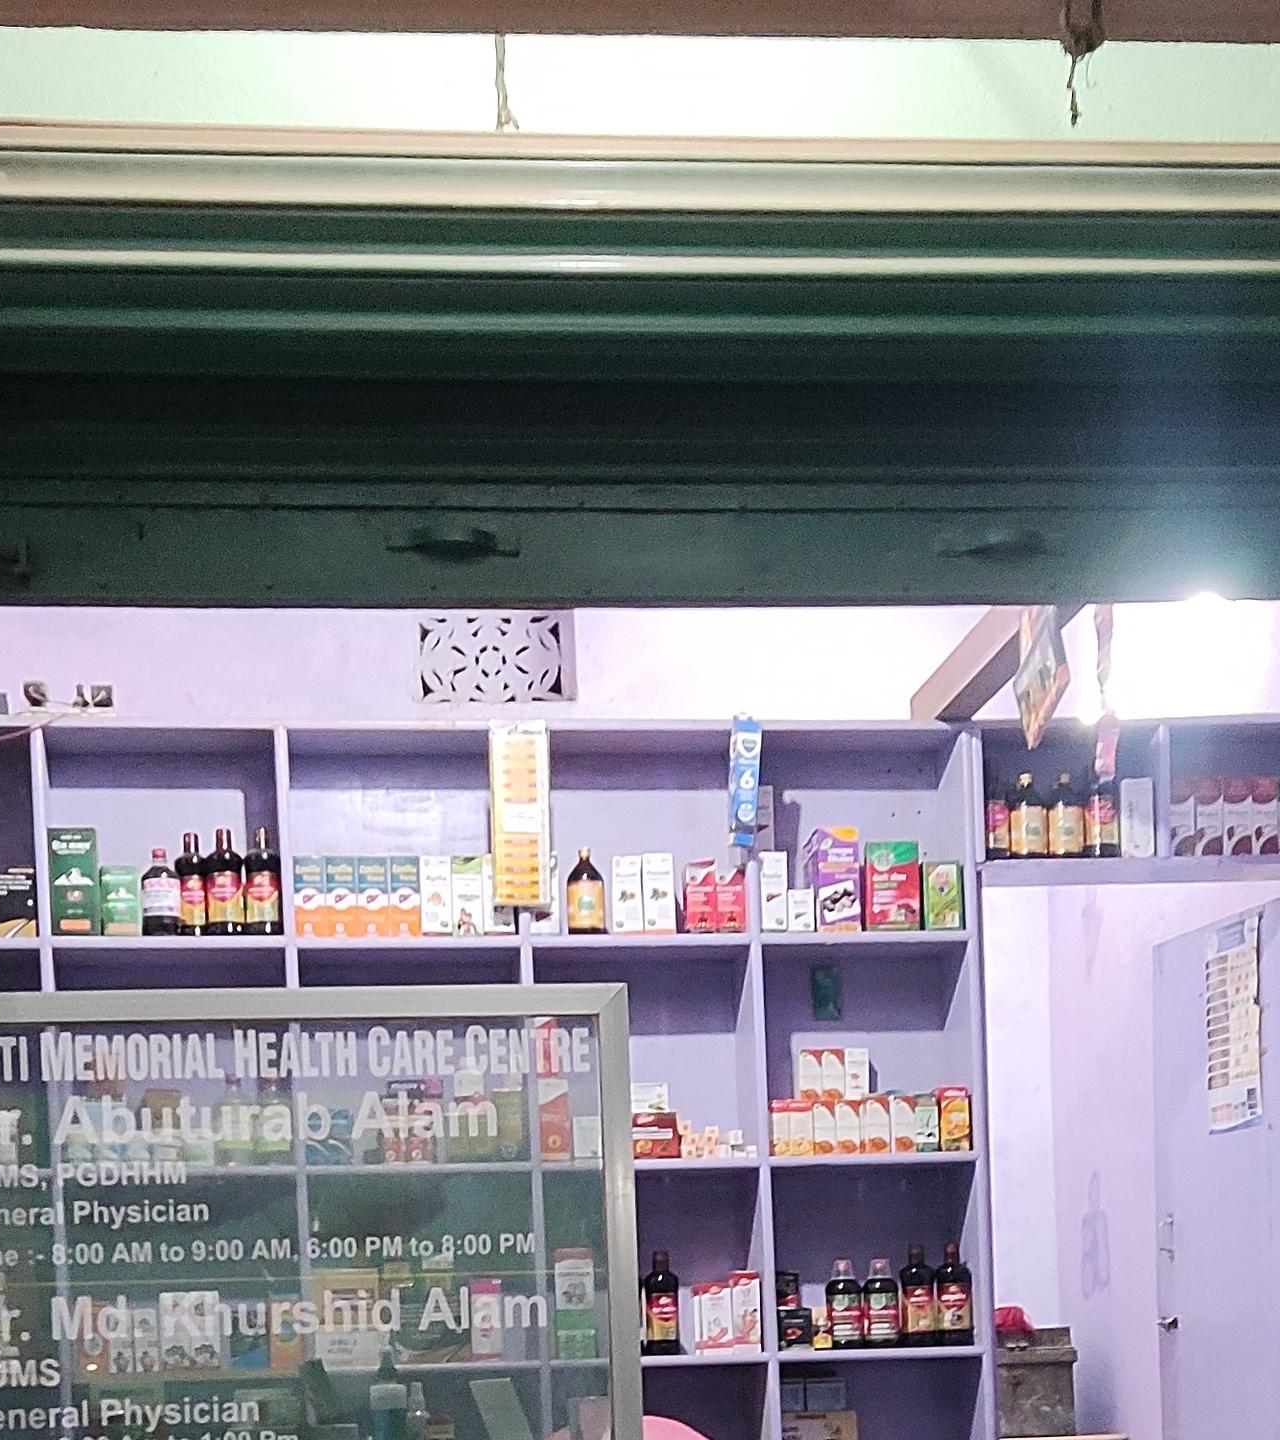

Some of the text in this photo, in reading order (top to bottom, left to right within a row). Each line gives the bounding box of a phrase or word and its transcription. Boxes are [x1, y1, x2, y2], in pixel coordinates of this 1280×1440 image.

[40, 1031, 225, 1082] MEMORIAL
[233, 1026, 358, 1078] HEALTH
[368, 1025, 455, 1077] CARE
[465, 1025, 592, 1075] CENTRE
[54, 1092, 331, 1145] Abuturab
[352, 1091, 498, 1139] Alam
[57, 1161, 187, 1187] PGDHHM
[73, 1198, 210, 1229] Physician
[52, 1243, 104, 1265] 8:00
[112, 1242, 152, 1263] AM
[160, 1242, 184, 1263] to
[192, 1239, 244, 1261] 9:00
[308, 1236, 358, 1258] 6:00
[365, 1236, 403, 1257] PM
[410, 1235, 434, 1257] to
[441, 1234, 492, 1255] 8:00
[499, 1233, 536, 1254] PM
[159, 1288, 401, 1337] Khurshid
[418, 1287, 548, 1332] Alam
[101, 1396, 260, 1432] Physician
